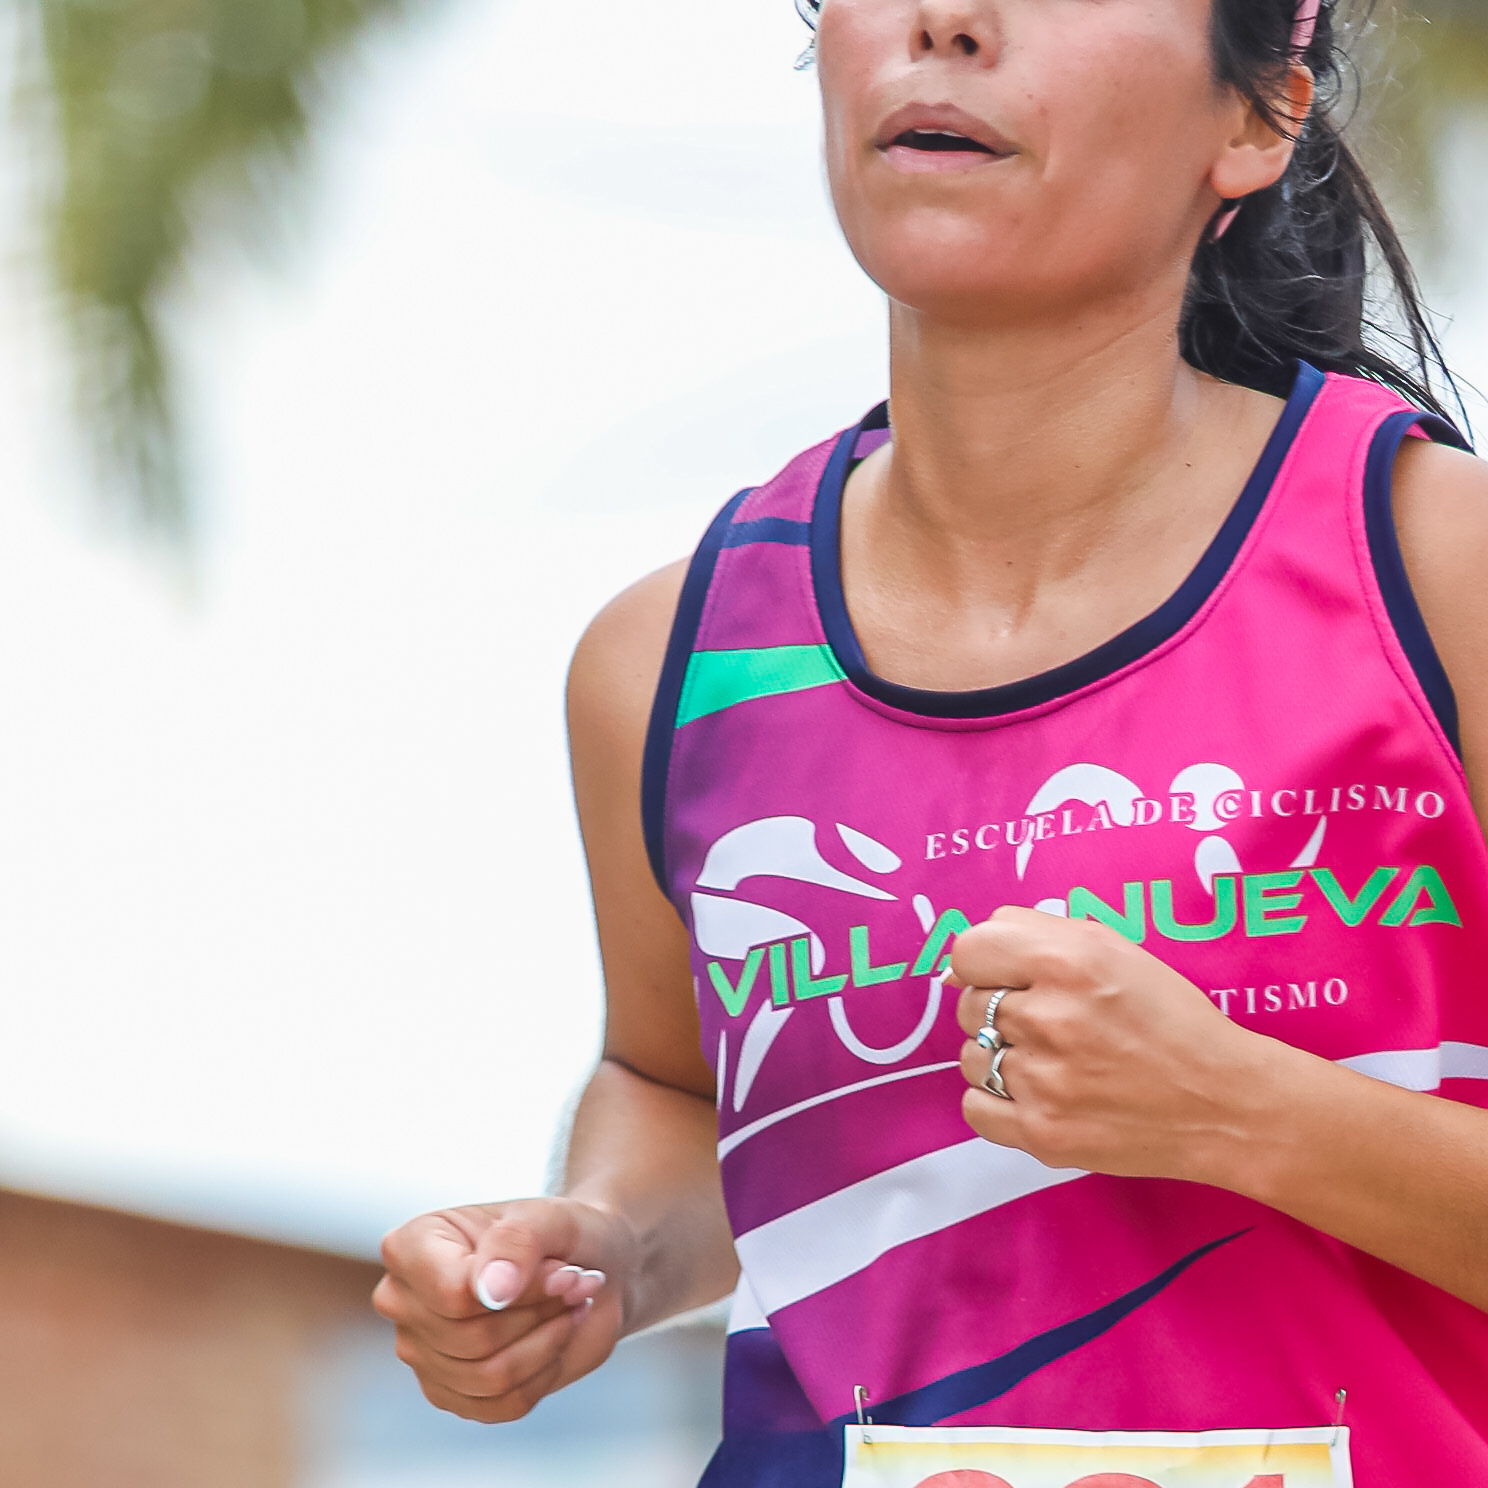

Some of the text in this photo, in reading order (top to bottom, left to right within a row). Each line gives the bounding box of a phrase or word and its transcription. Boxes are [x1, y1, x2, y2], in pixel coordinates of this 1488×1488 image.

[924, 783, 1446, 861] ESCUELA DE CICLISMO
[1067, 864, 1464, 945] NUEVA
[1209, 977, 1349, 1016] TISMO
